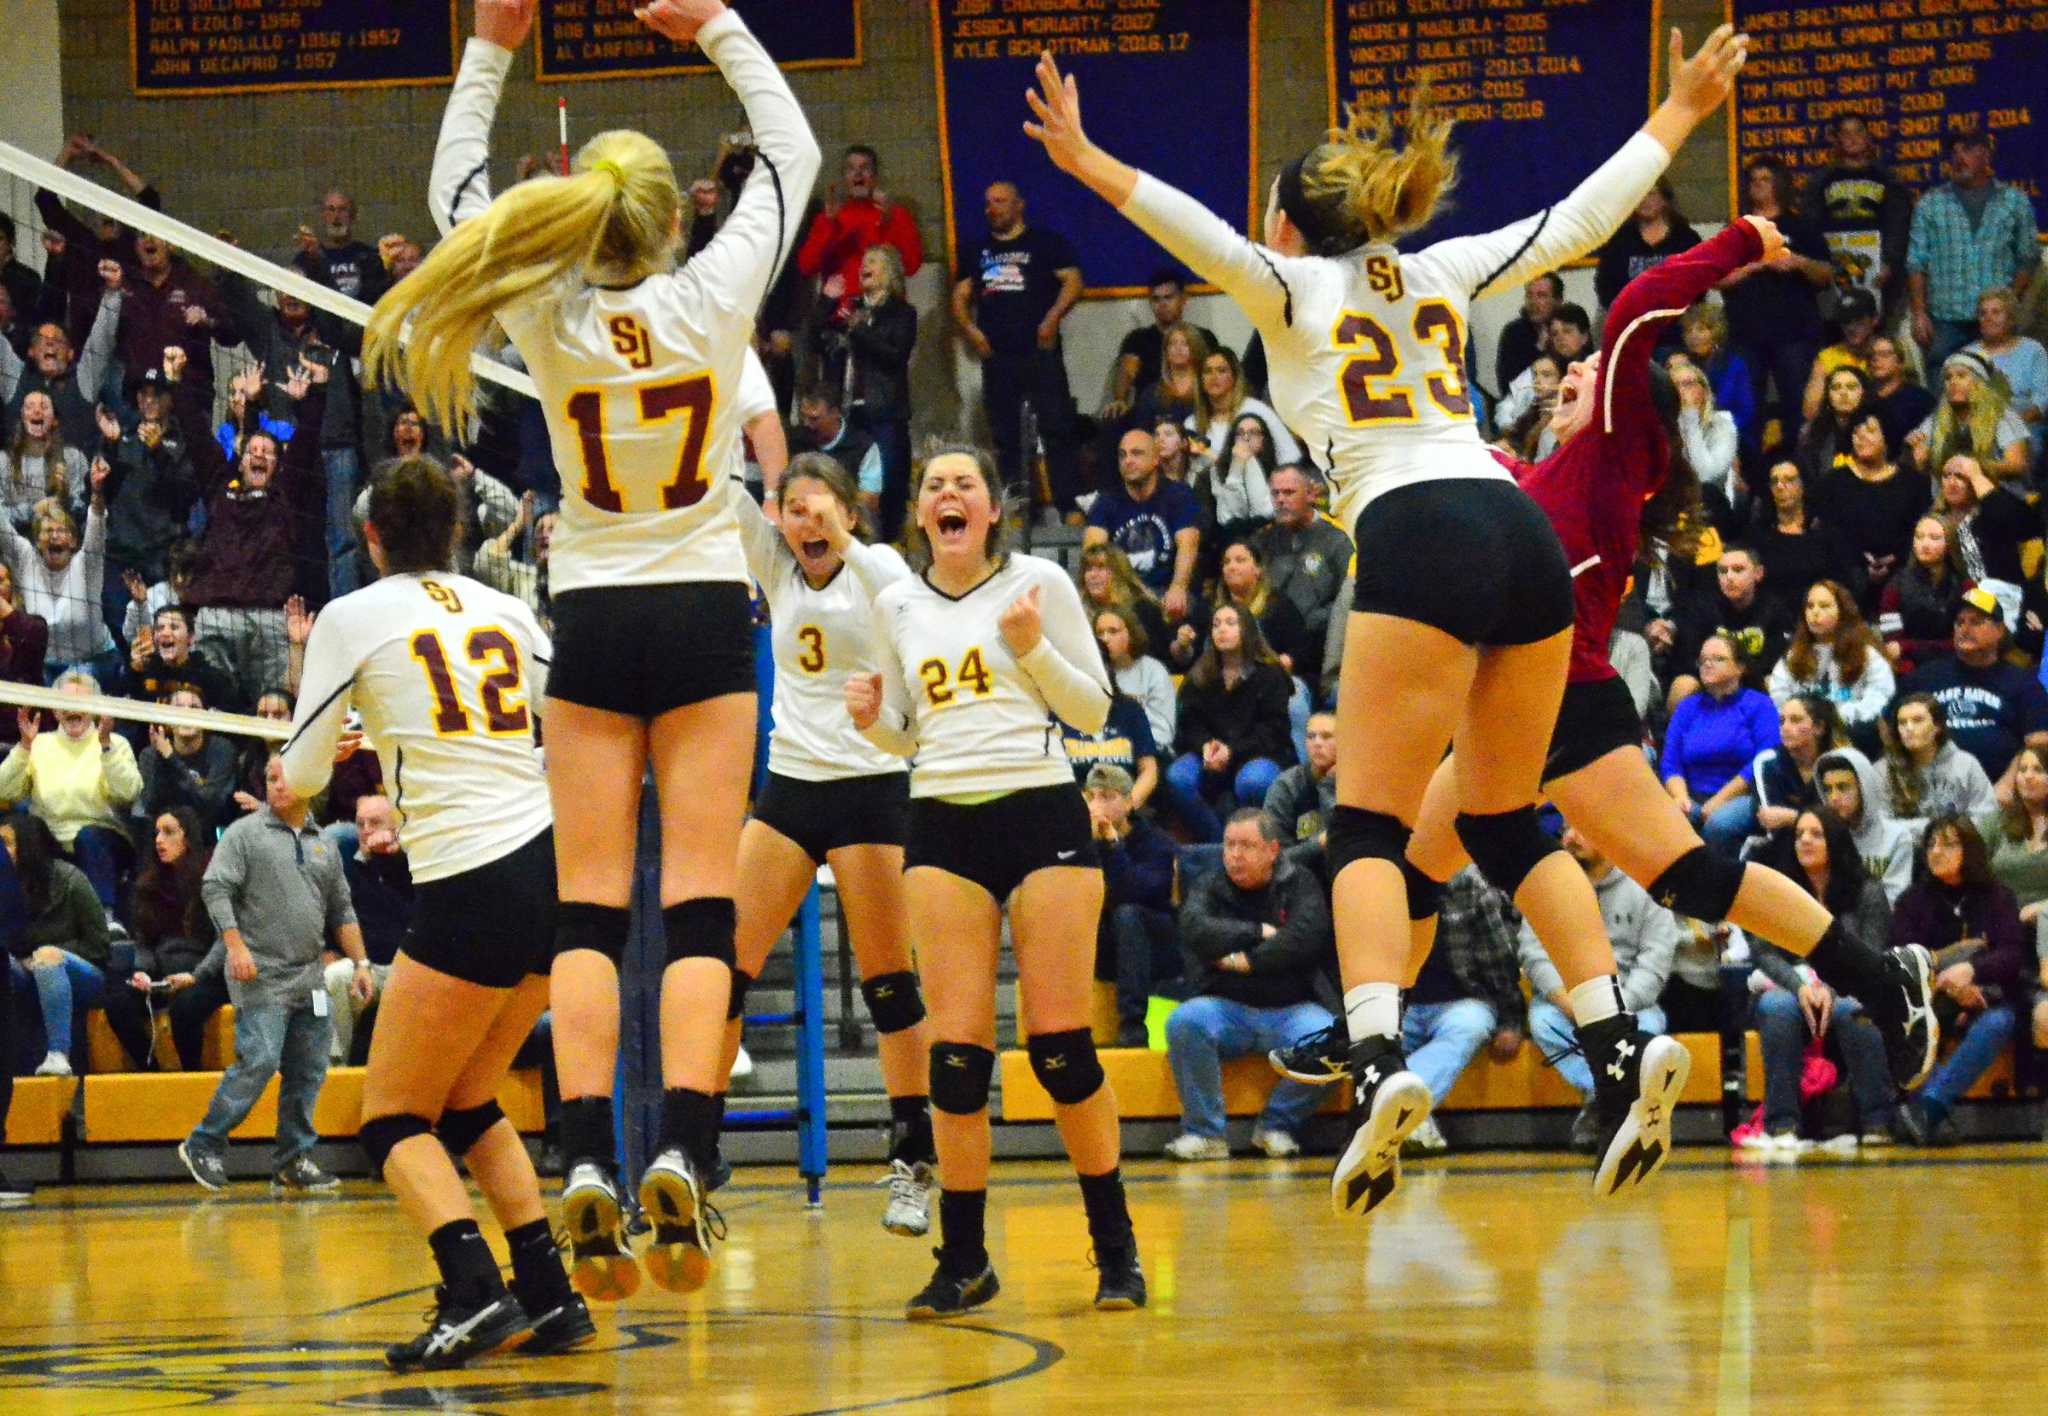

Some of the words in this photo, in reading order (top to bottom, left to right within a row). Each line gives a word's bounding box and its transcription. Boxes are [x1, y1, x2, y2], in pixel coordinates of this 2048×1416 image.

[1366, 255, 1405, 303] SJ
[608, 315, 653, 370] SJ
[1331, 295, 1475, 429] 23
[561, 368, 720, 513] 17
[408, 624, 533, 738] 12
[798, 623, 827, 675] 3
[918, 645, 994, 710] 24
